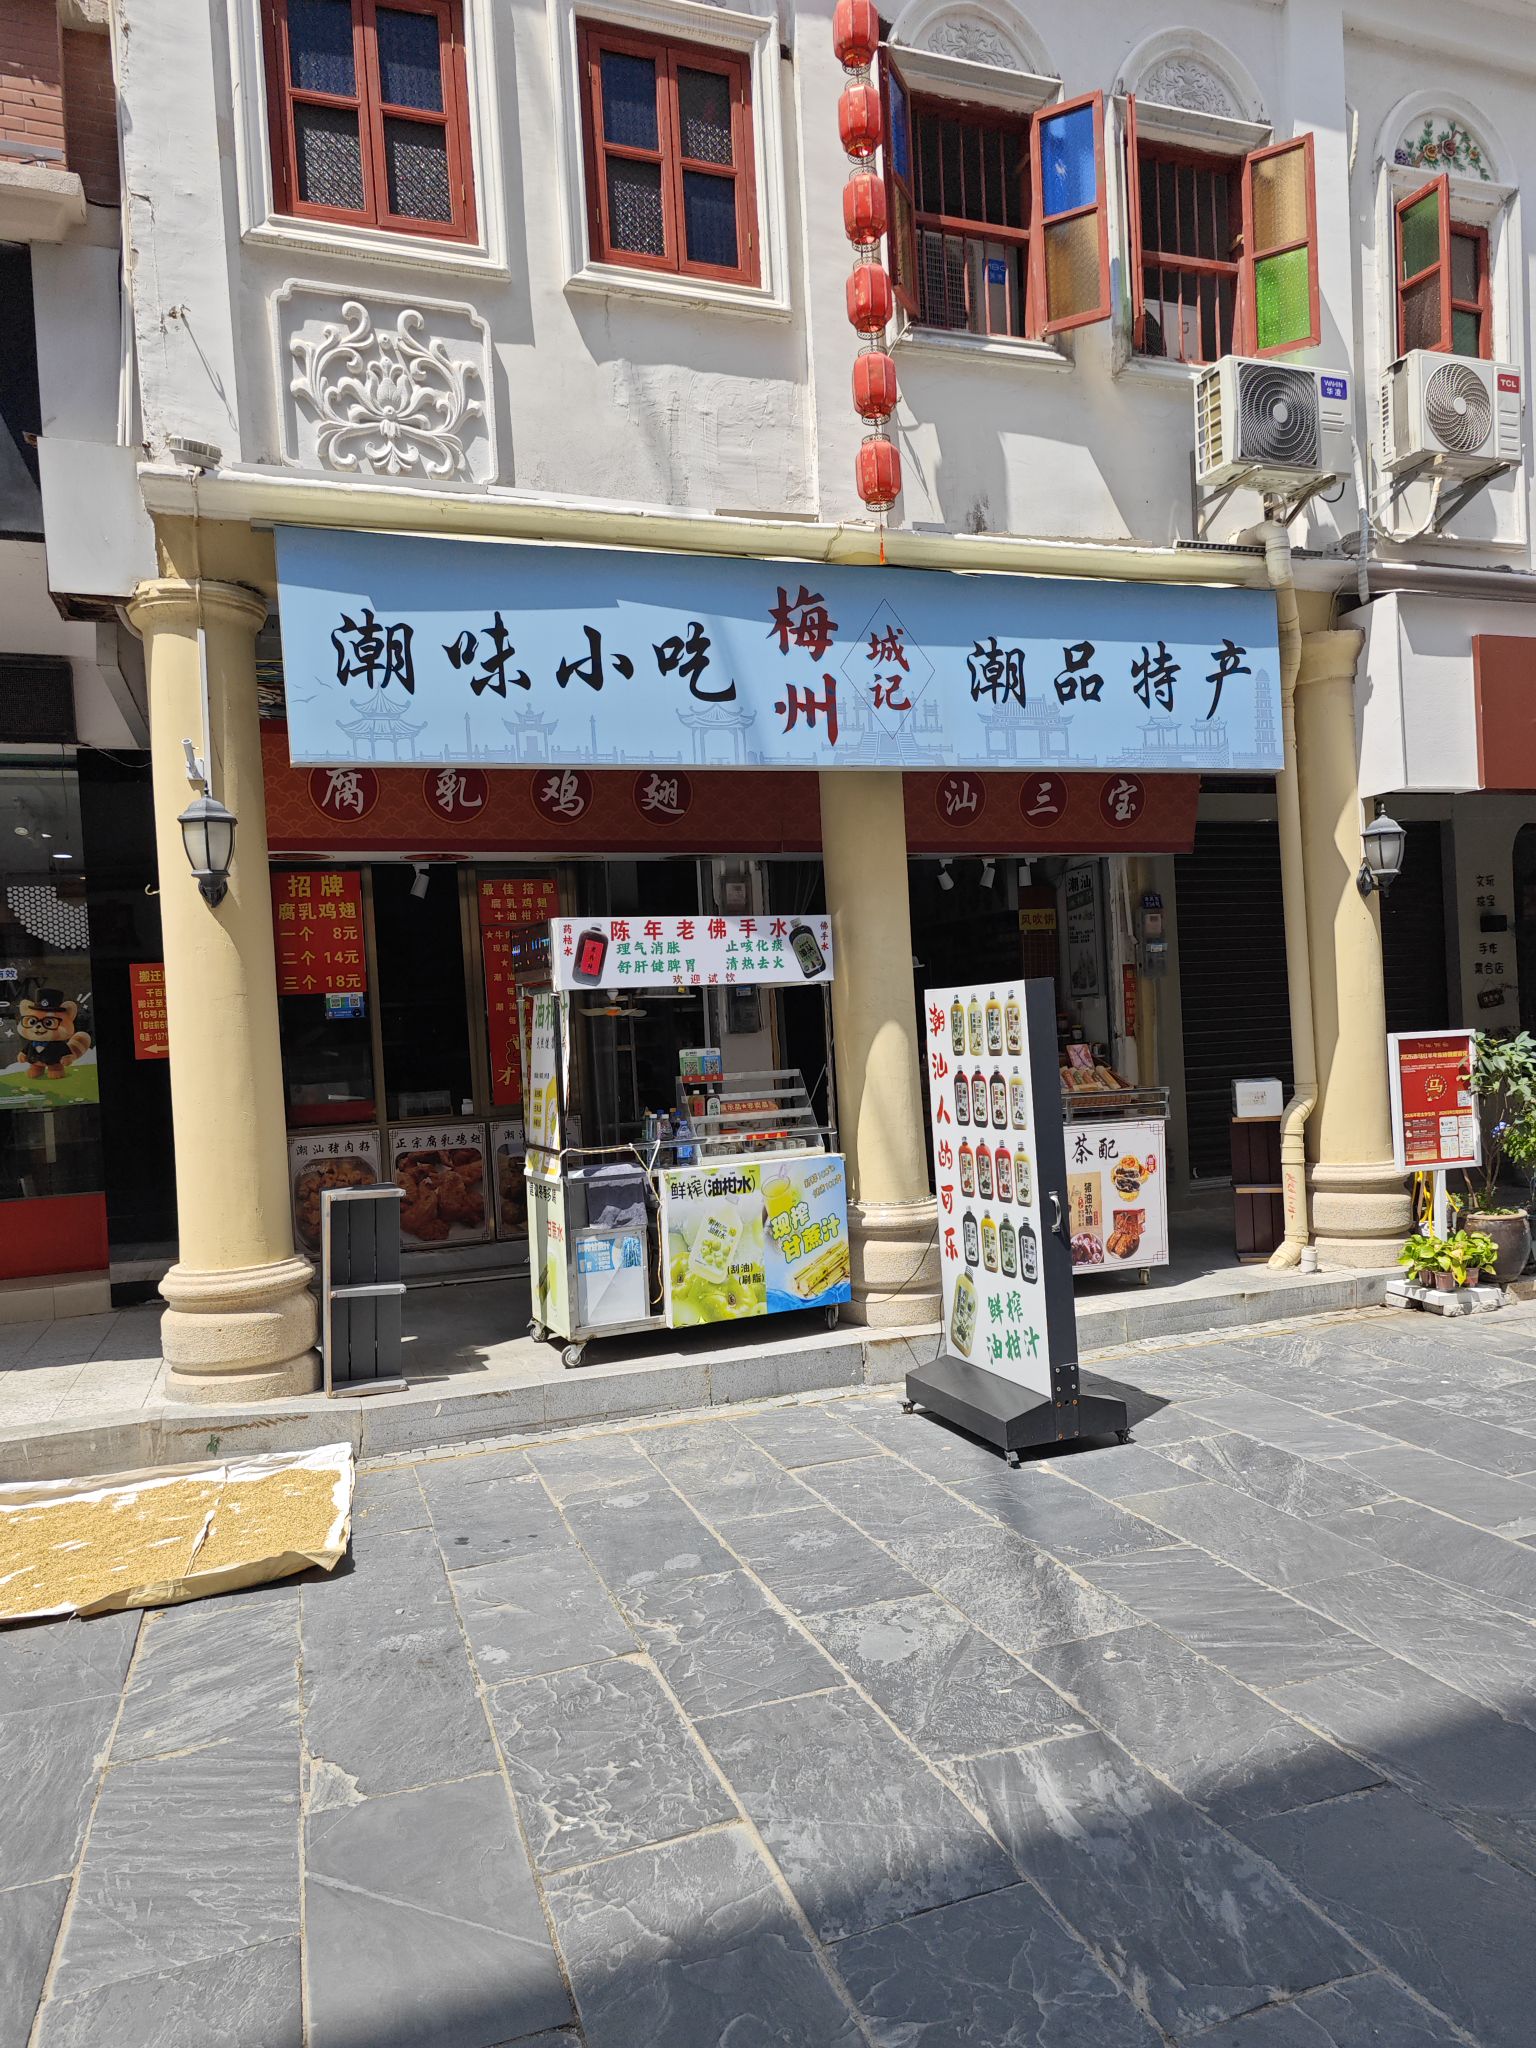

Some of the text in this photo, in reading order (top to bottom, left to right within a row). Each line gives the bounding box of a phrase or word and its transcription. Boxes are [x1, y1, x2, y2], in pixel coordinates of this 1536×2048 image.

[1500, 379, 1517, 388] TCL
[331, 608, 737, 702] 潮味小吃
[766, 585, 839, 746] 梅州
[866, 625, 912, 712] 城记
[966, 636, 1252, 720] 潮品特产
[321, 769, 687, 817] 腐乳鸡翅
[944, 780, 1140, 821] 汕三宝
[288, 875, 345, 898] 招牌
[482, 883, 555, 896] 最佳搭配
[279, 902, 357, 921] 腐乳鸡翅
[491, 898, 548, 909] 腐乳鸡翅
[279, 926, 358, 942] 一个 8元
[610, 918, 788, 941] 陈年老佛手水
[820, 921, 830, 951] 佛手水
[282, 949, 360, 966] 二个 14元
[616, 939, 785, 956] 理气消胀 止咳化痰
[139, 970, 165, 982] 搬迁
[617, 955, 785, 974] 舒肝健脾胃 清热去火
[283, 973, 362, 990] 三个 18元
[672, 973, 737, 985] 欢迎试饮
[395, 1133, 482, 1150] 正宗腐乳鸡翅
[929, 1002, 960, 1262] 潮汕人的可乐
[1072, 1133, 1119, 1165] 茶配
[770, 1202, 811, 1241] 现榨
[781, 1213, 841, 1264] 甘蔗汁
[987, 1290, 1024, 1326] 鲜榨
[986, 1326, 1040, 1365] 油柑汁
